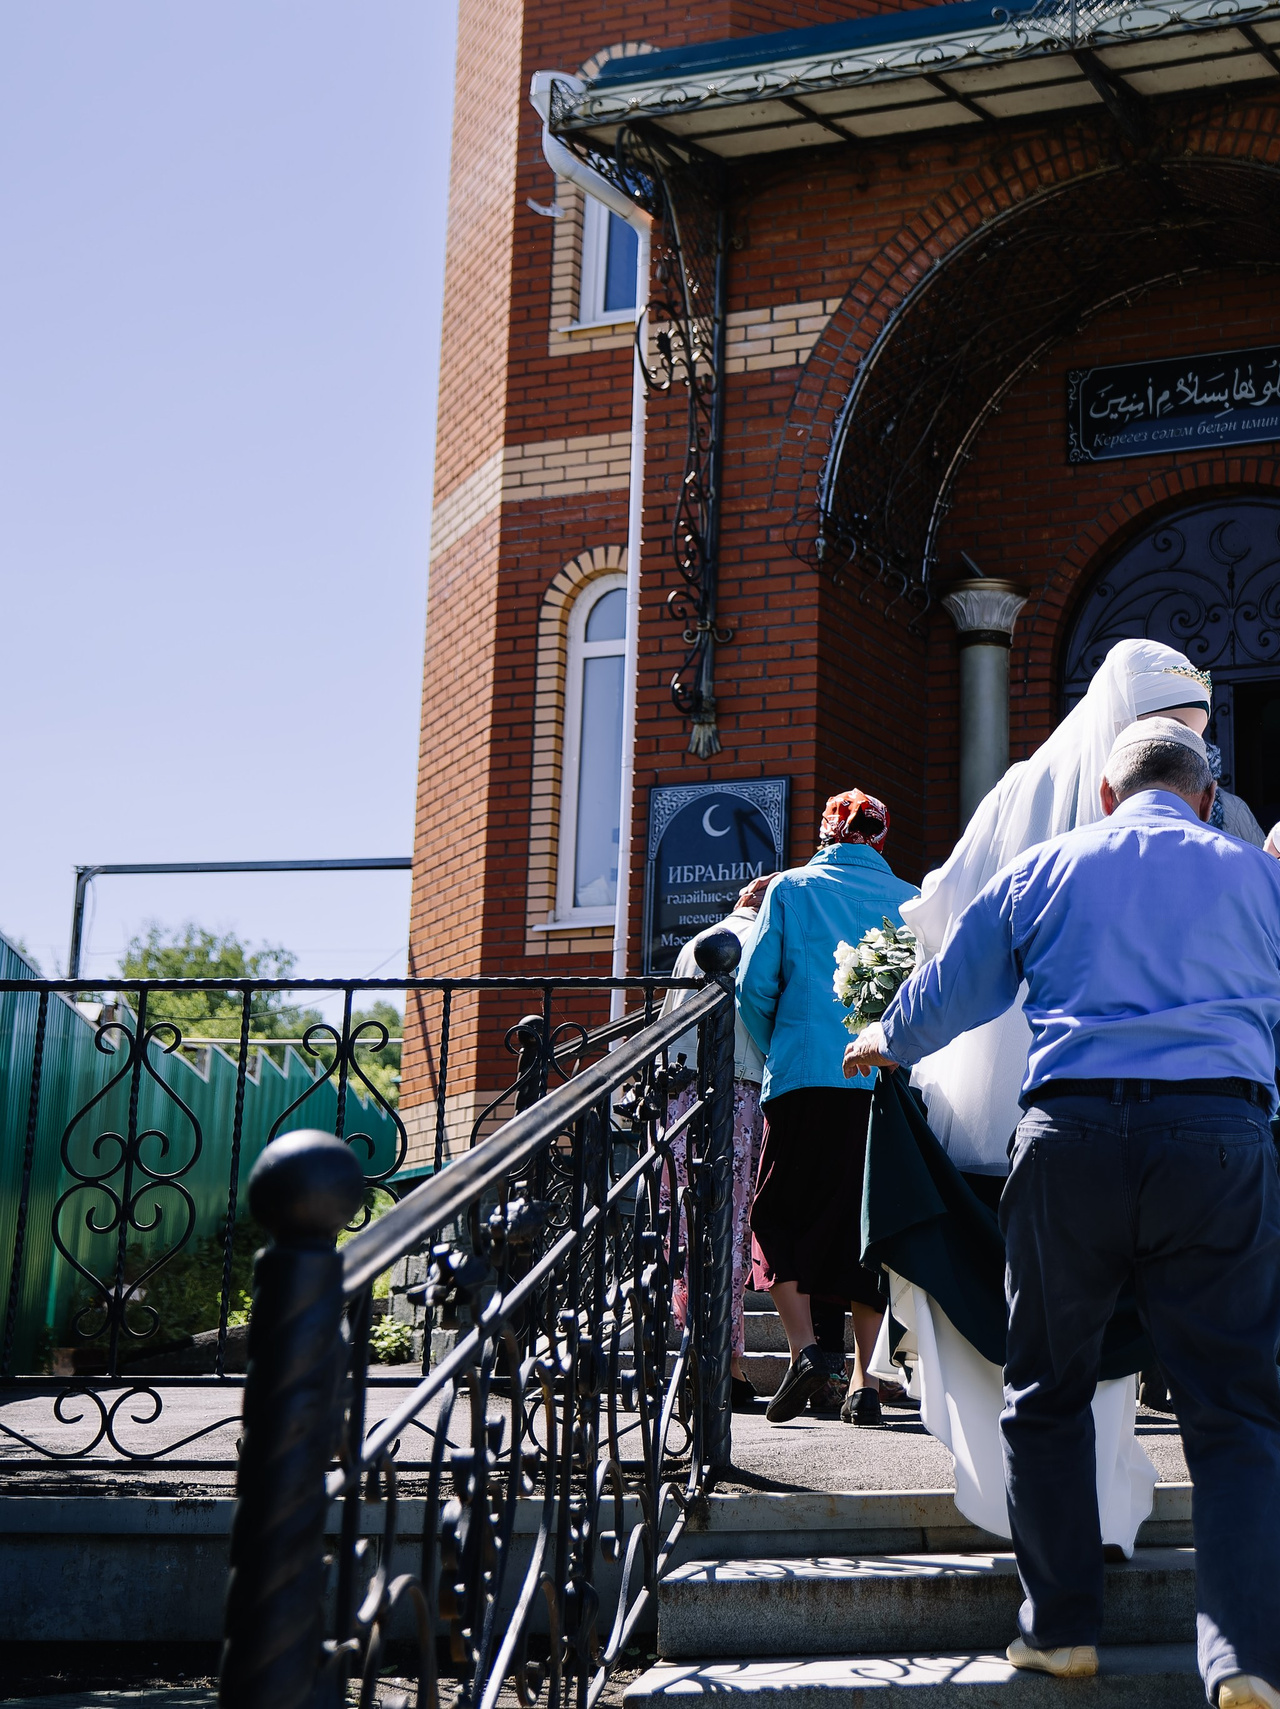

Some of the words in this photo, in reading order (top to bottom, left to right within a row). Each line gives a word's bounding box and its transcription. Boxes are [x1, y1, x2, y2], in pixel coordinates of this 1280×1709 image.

[1093, 431, 1148, 448] Керегез
[1197, 420, 1237, 435] белән
[1241, 416, 1279, 430] имин
[660, 932, 693, 948] Мәс
